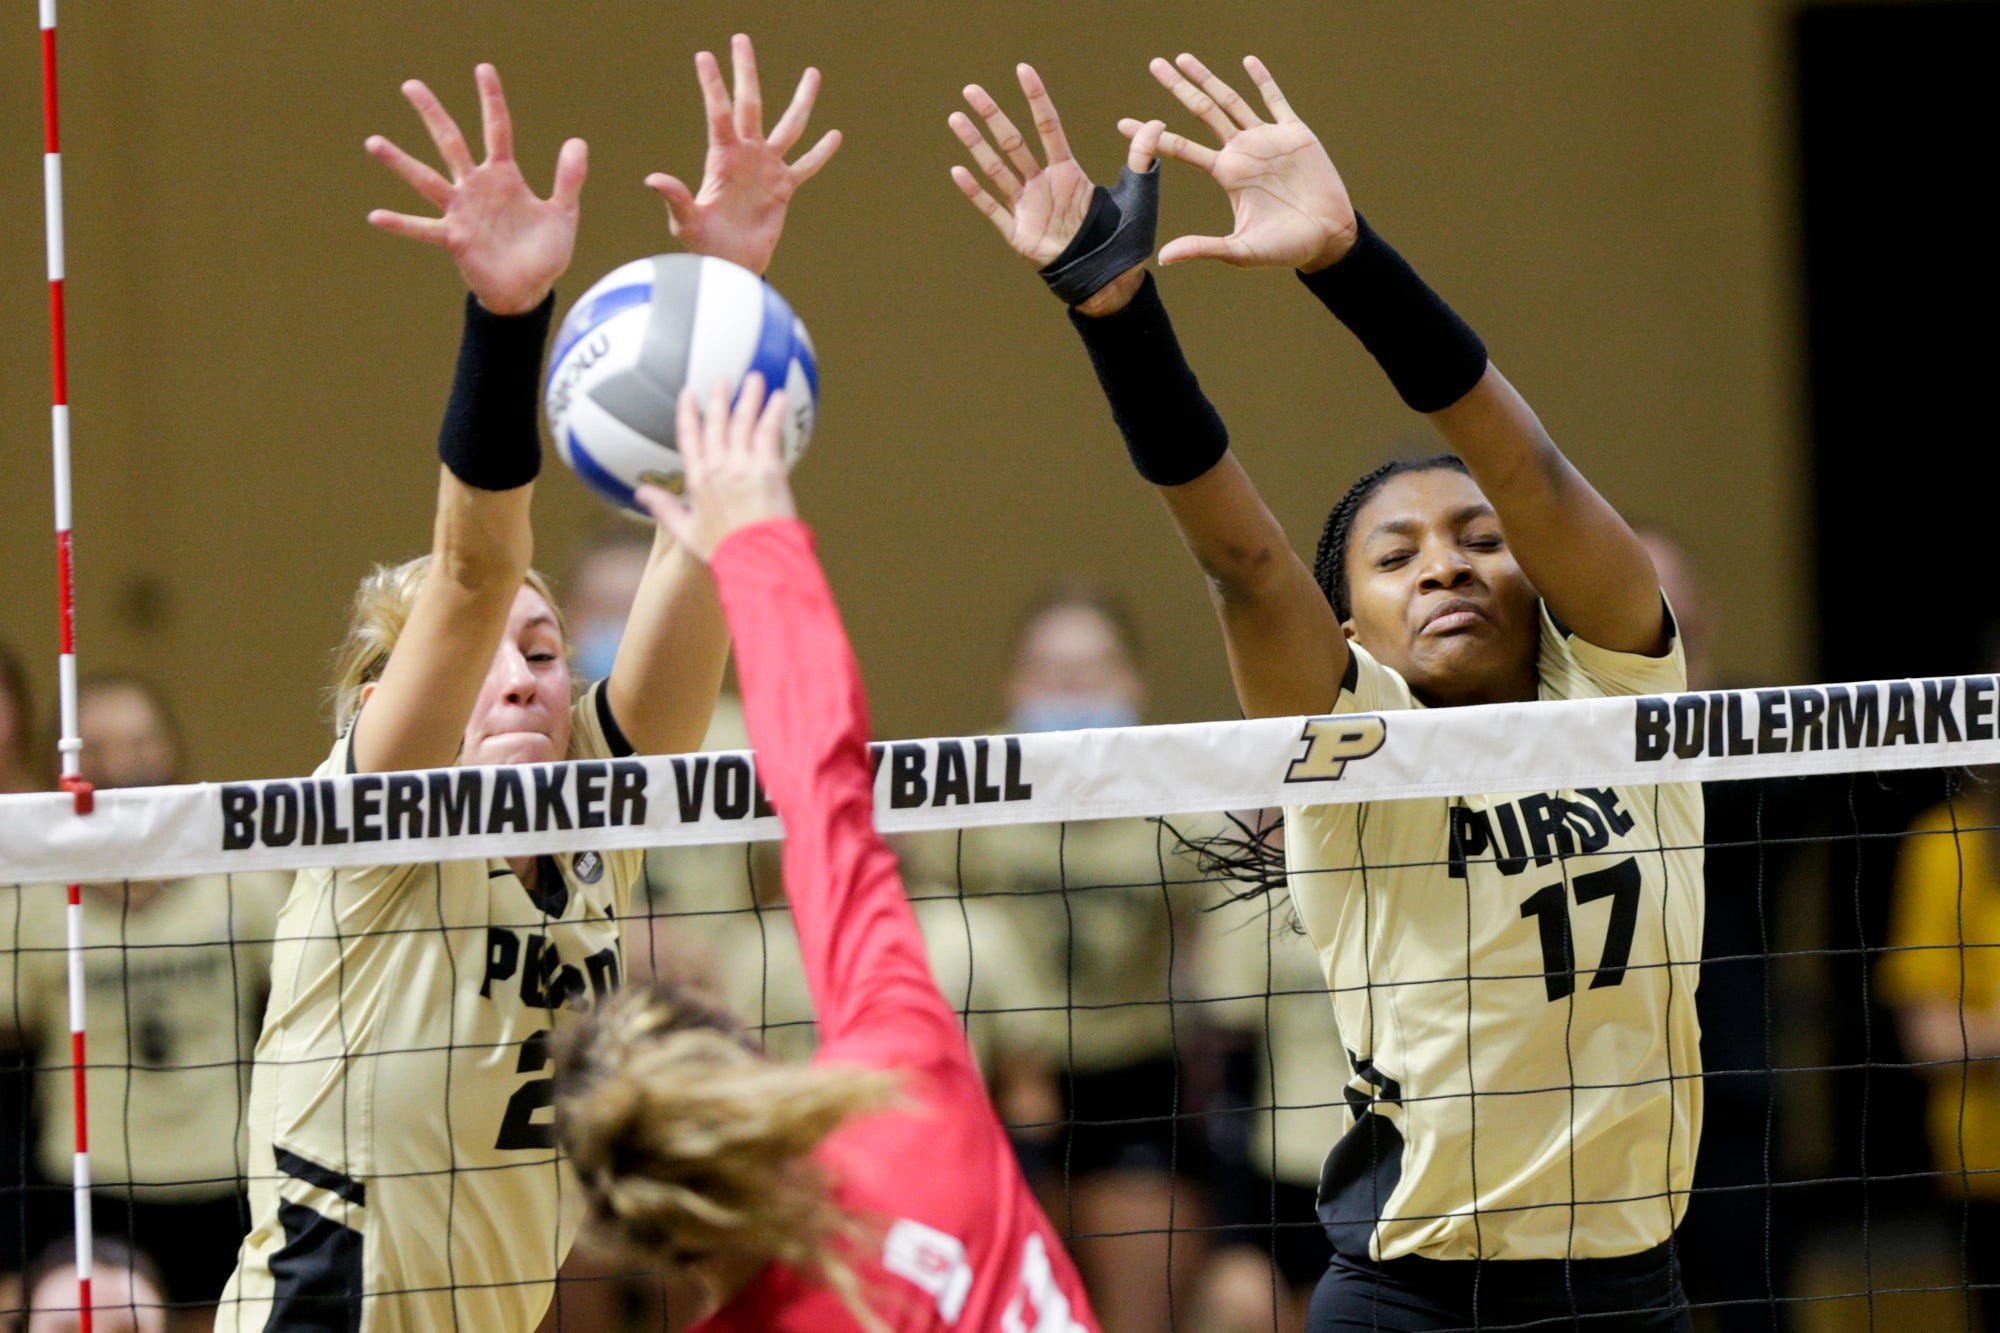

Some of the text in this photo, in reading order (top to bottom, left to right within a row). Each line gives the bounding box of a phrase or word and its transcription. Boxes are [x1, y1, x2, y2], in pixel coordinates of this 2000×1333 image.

[1283, 715, 1387, 783] P
[1635, 675, 2000, 762] BOILERMAKE
[221, 760, 648, 851] BOILERMAKER
[1520, 856, 1642, 1002] 17
